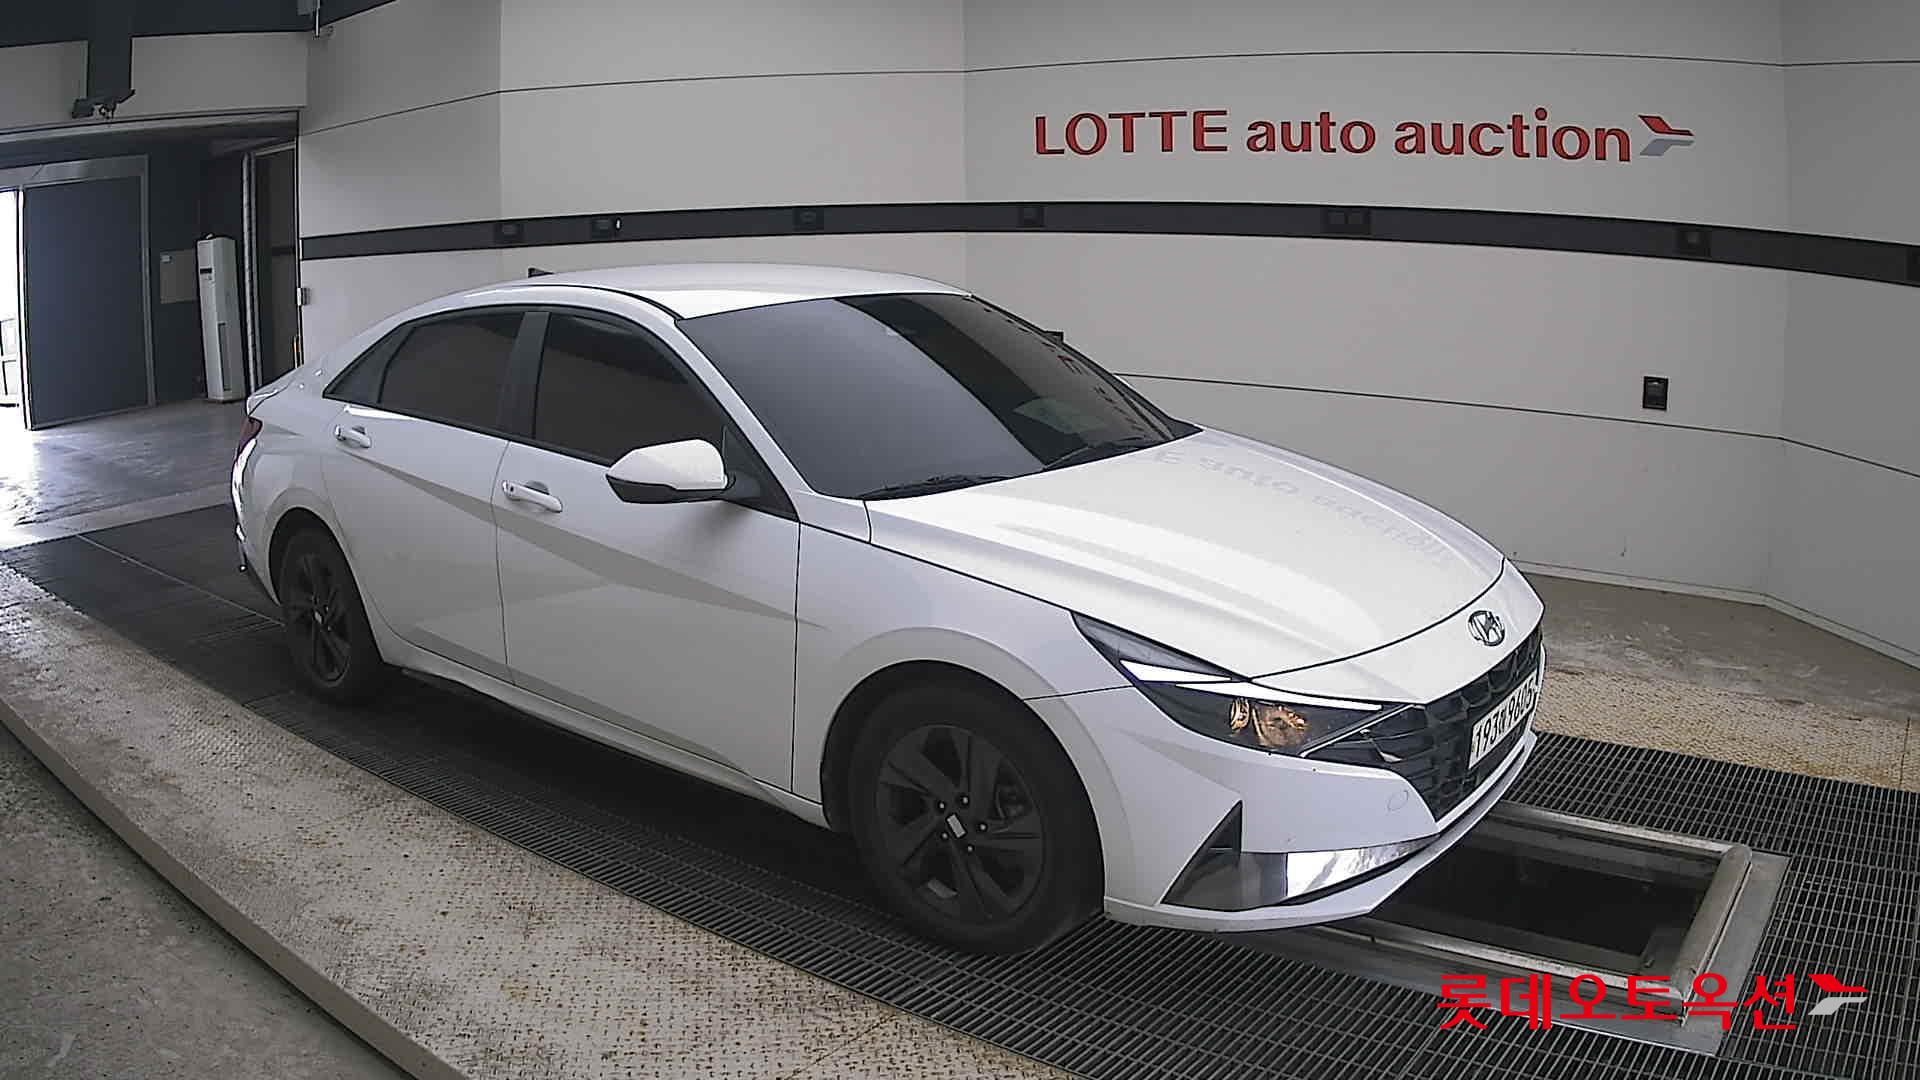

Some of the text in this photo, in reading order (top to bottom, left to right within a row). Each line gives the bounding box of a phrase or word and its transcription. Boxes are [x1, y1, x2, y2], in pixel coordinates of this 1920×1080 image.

[1035, 107, 1631, 162] LOTTE auto auction
